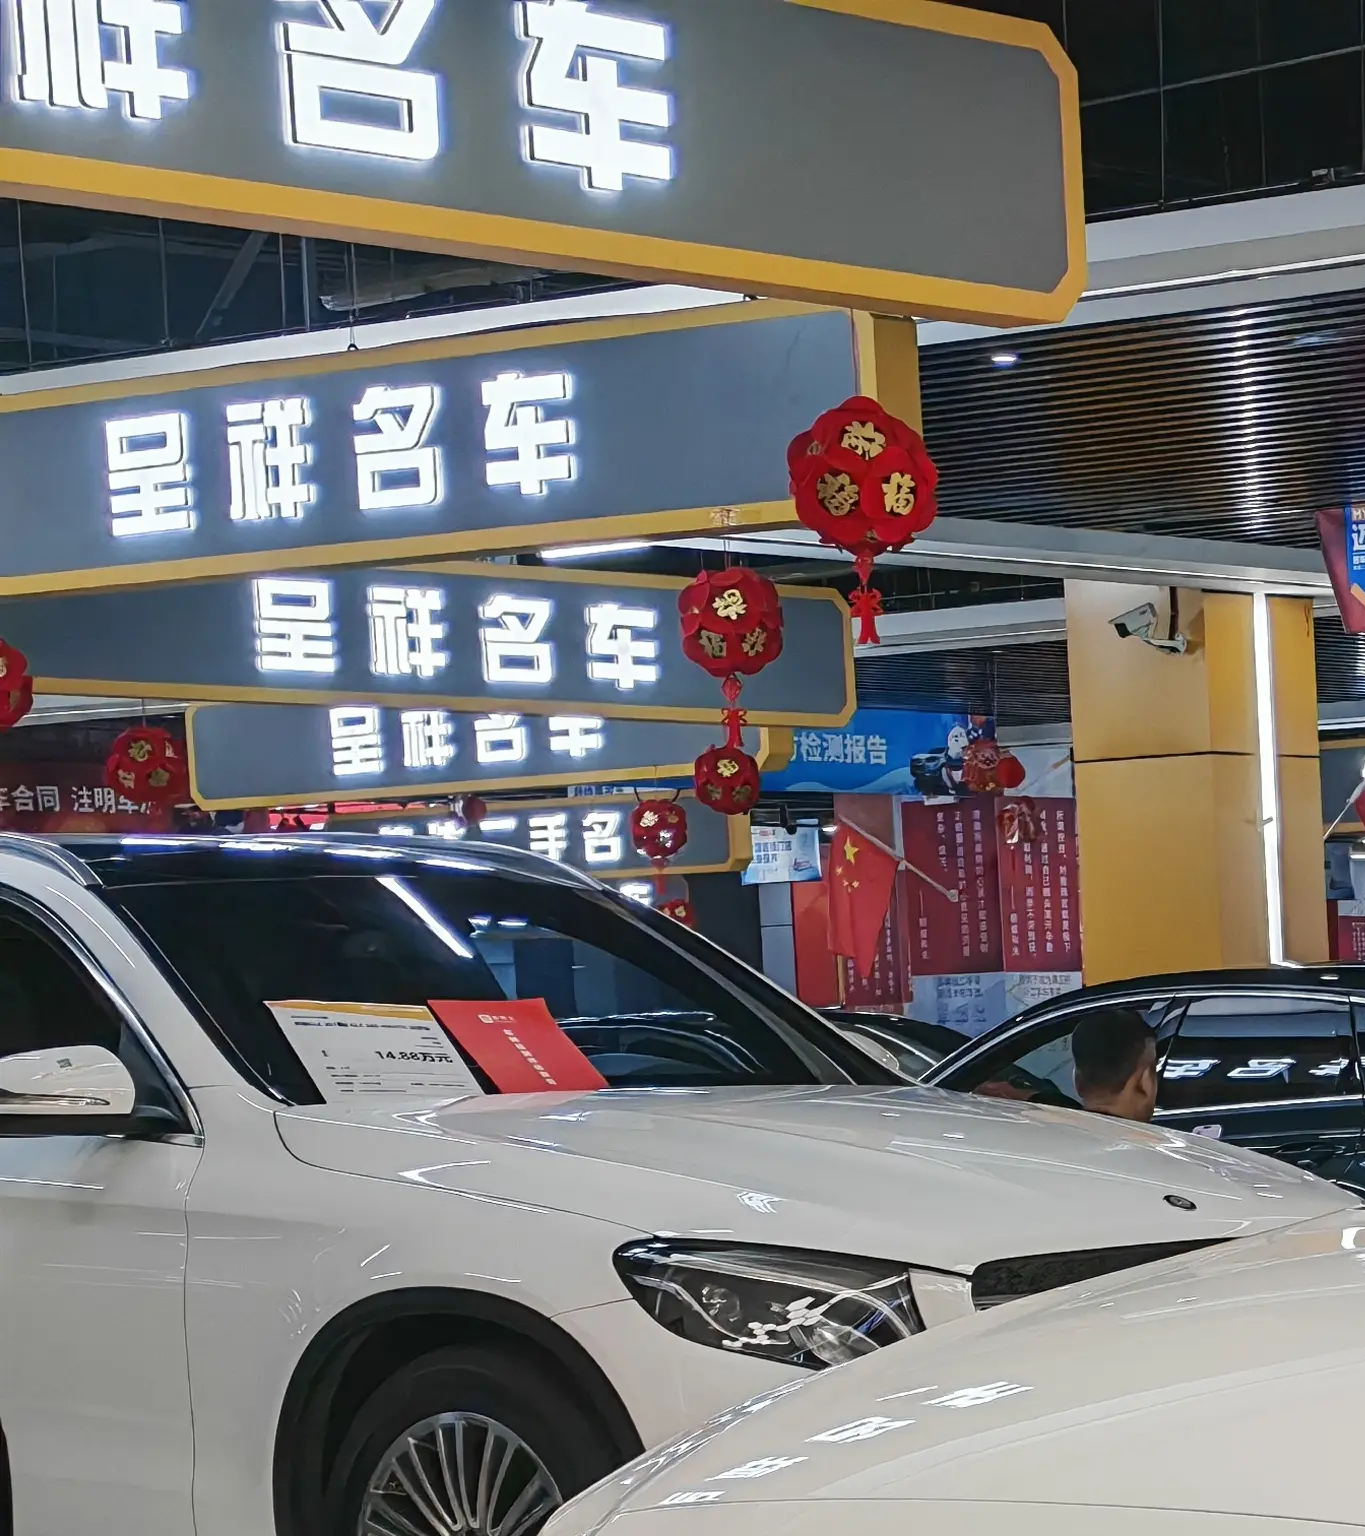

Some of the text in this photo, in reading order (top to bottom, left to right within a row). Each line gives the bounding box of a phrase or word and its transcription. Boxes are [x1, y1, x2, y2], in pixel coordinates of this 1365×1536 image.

[104, 370, 577, 539] 呈祥名车
[254, 578, 659, 689] 呈祥名车
[790, 731, 888, 765] 检测报告
